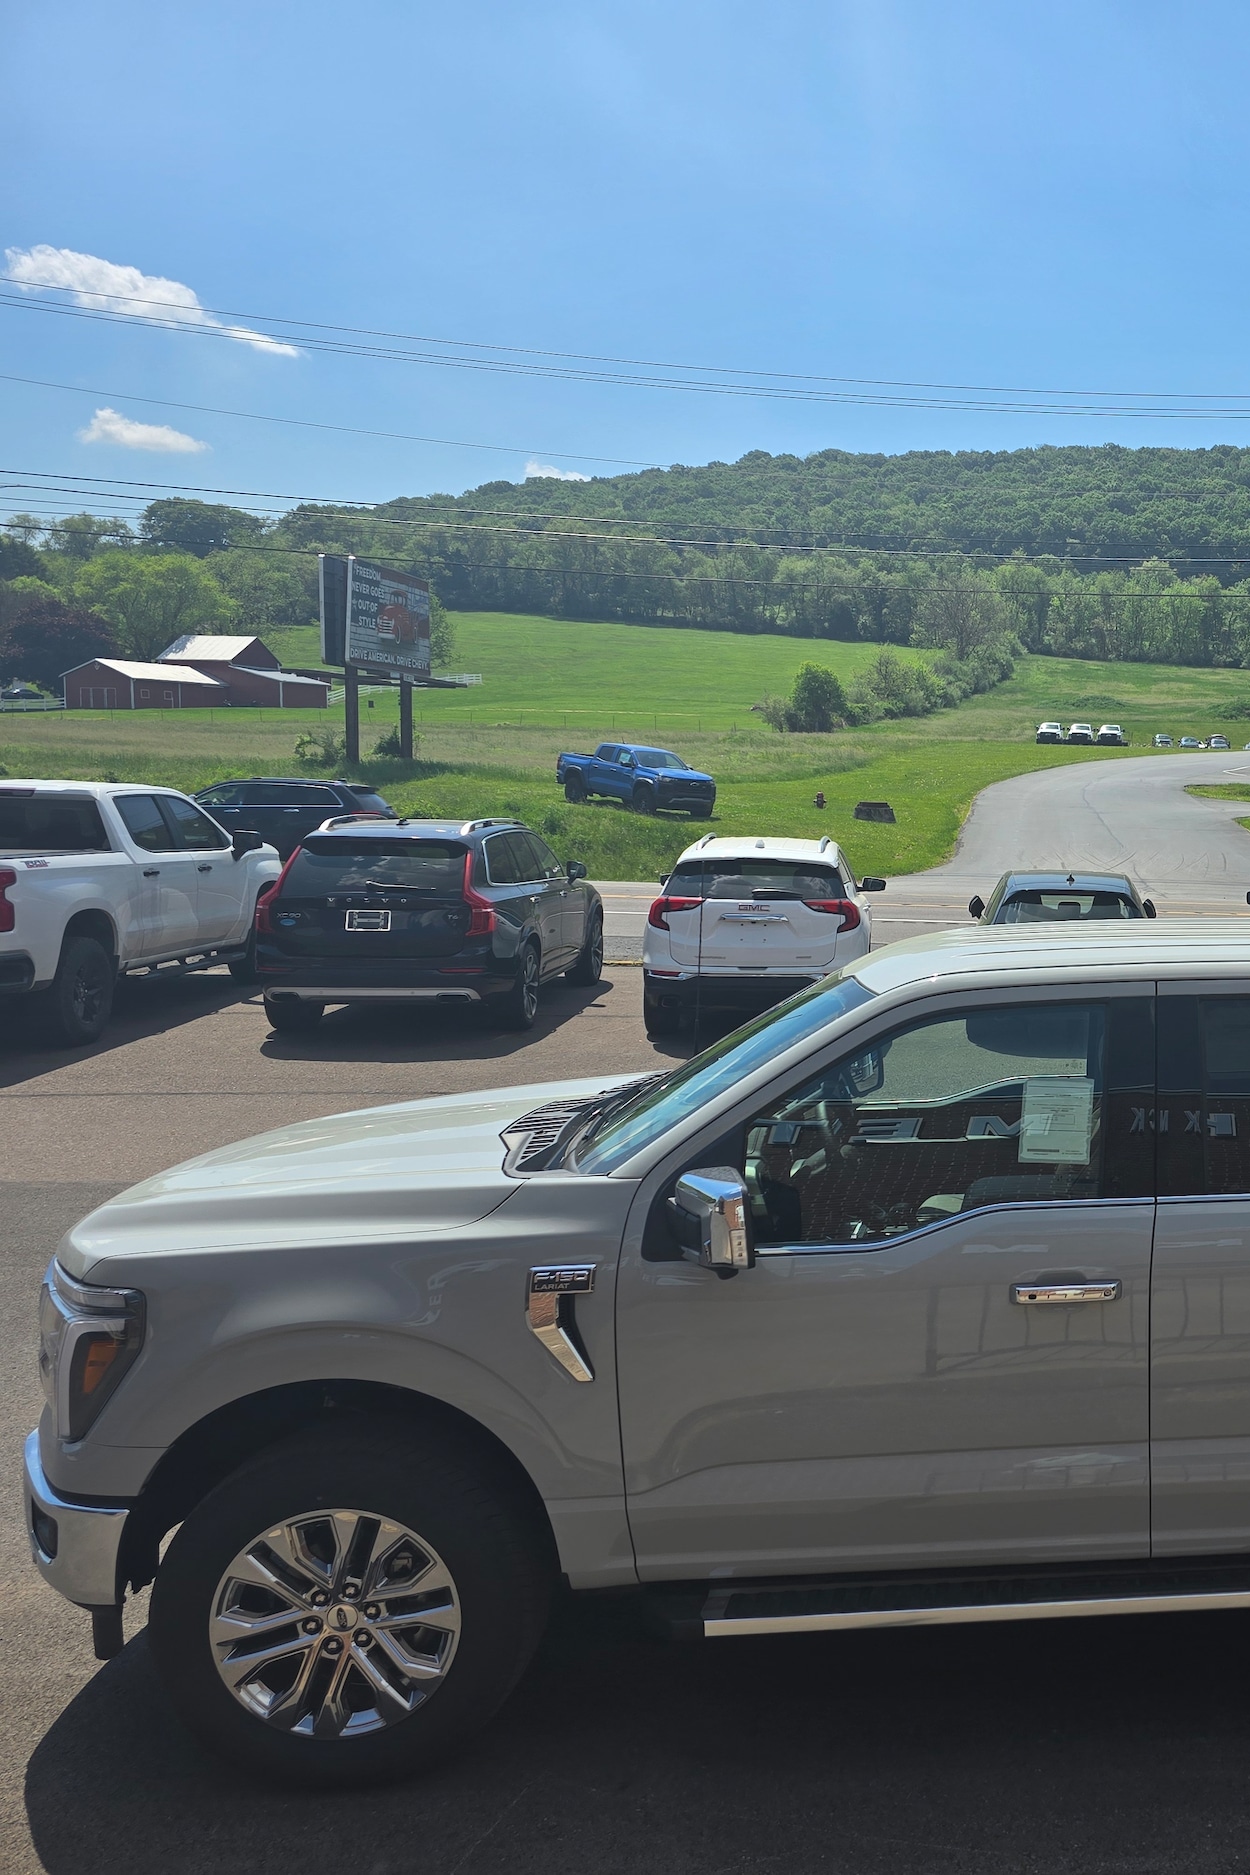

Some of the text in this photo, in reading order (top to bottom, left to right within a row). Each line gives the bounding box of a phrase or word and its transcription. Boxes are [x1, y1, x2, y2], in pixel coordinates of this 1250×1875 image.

[356, 564, 381, 581] FREEDOM
[352, 581, 385, 599] NEVER GOES
[357, 600, 378, 612] OUT OF
[350, 648, 429, 671] DRIVE AMERICAN. DRIVE CHEVY.
[738, 903, 770, 912] GMC
[534, 1270, 588, 1283] F-150
